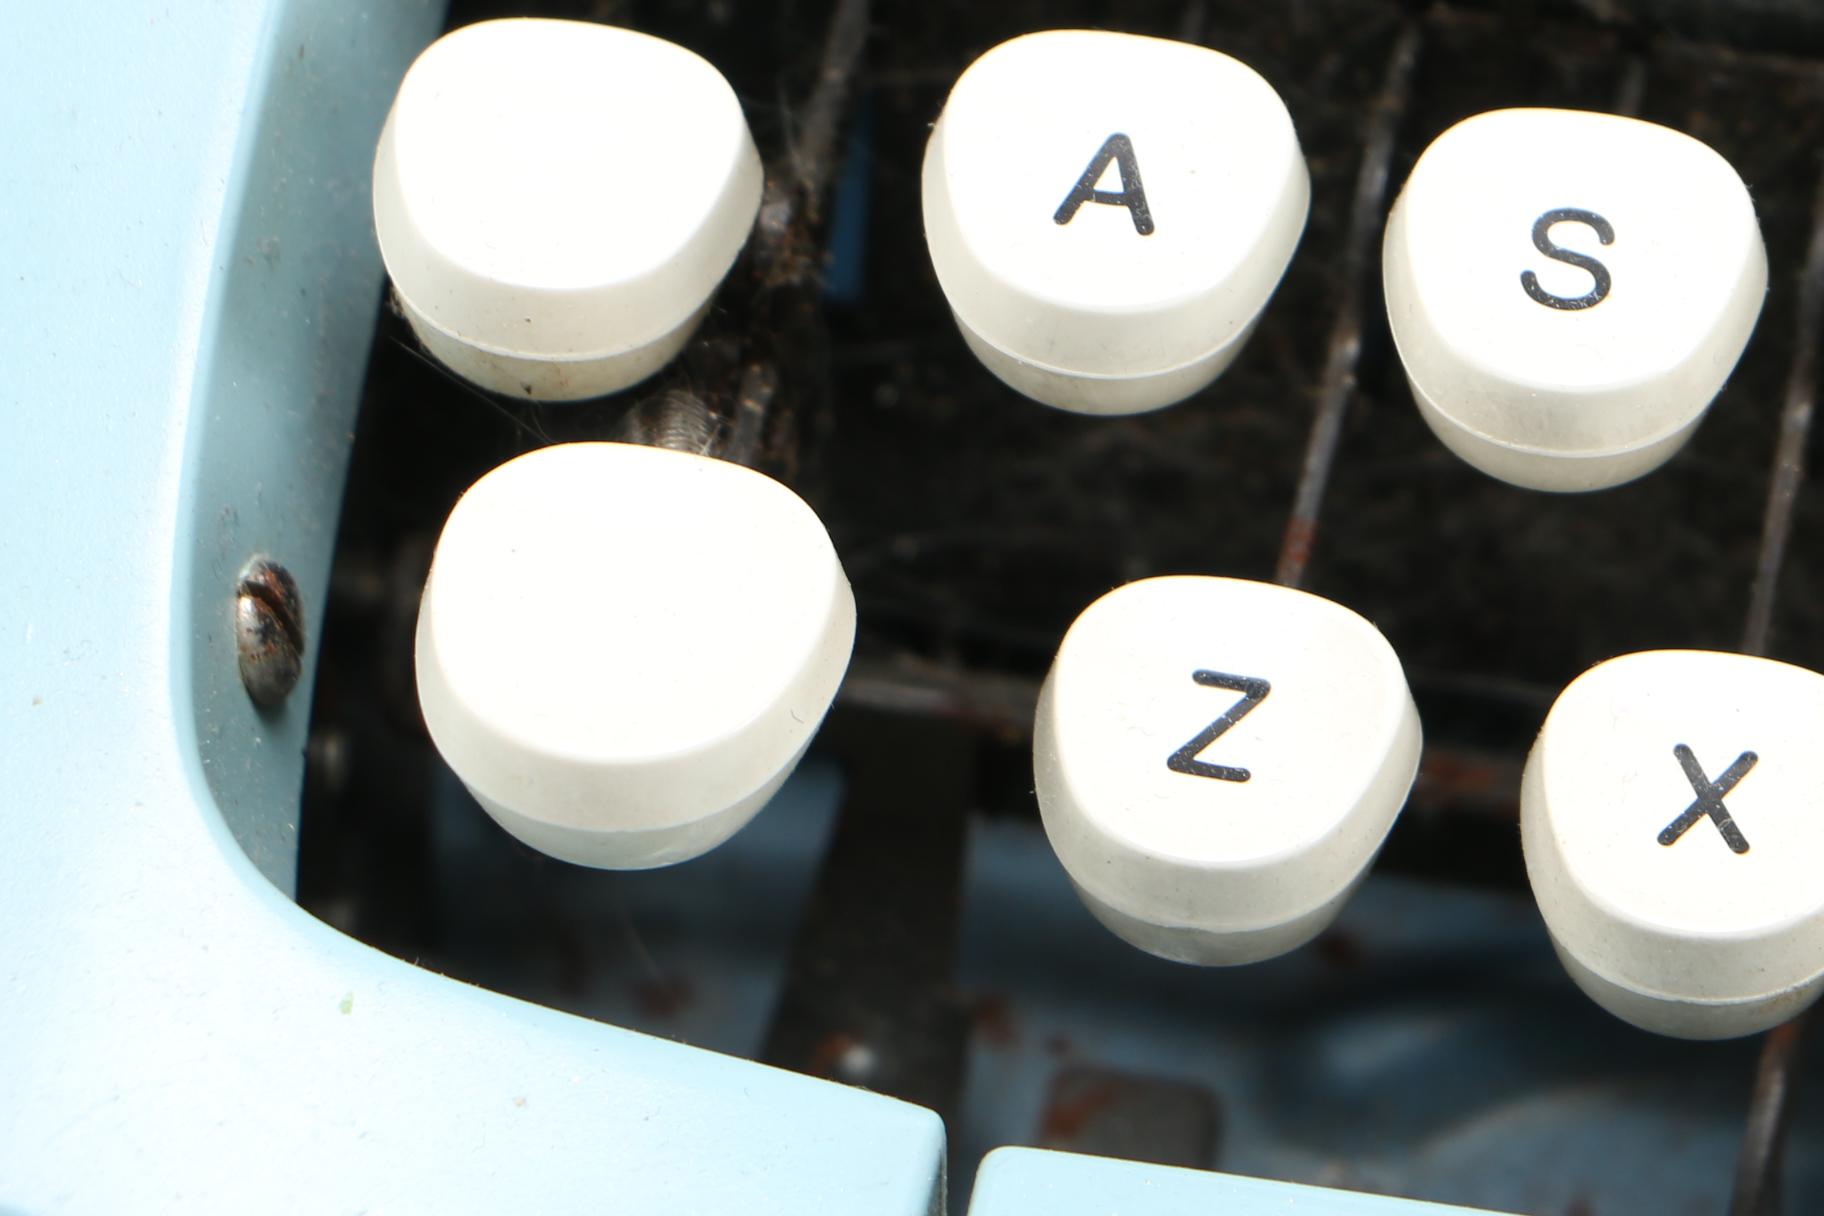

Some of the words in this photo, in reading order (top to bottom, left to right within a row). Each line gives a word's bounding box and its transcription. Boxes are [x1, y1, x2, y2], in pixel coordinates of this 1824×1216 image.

[1054, 134, 1154, 235] A
[1521, 209, 1614, 310] S
[1167, 671, 1270, 782] Z
[1658, 745, 1758, 854] X
